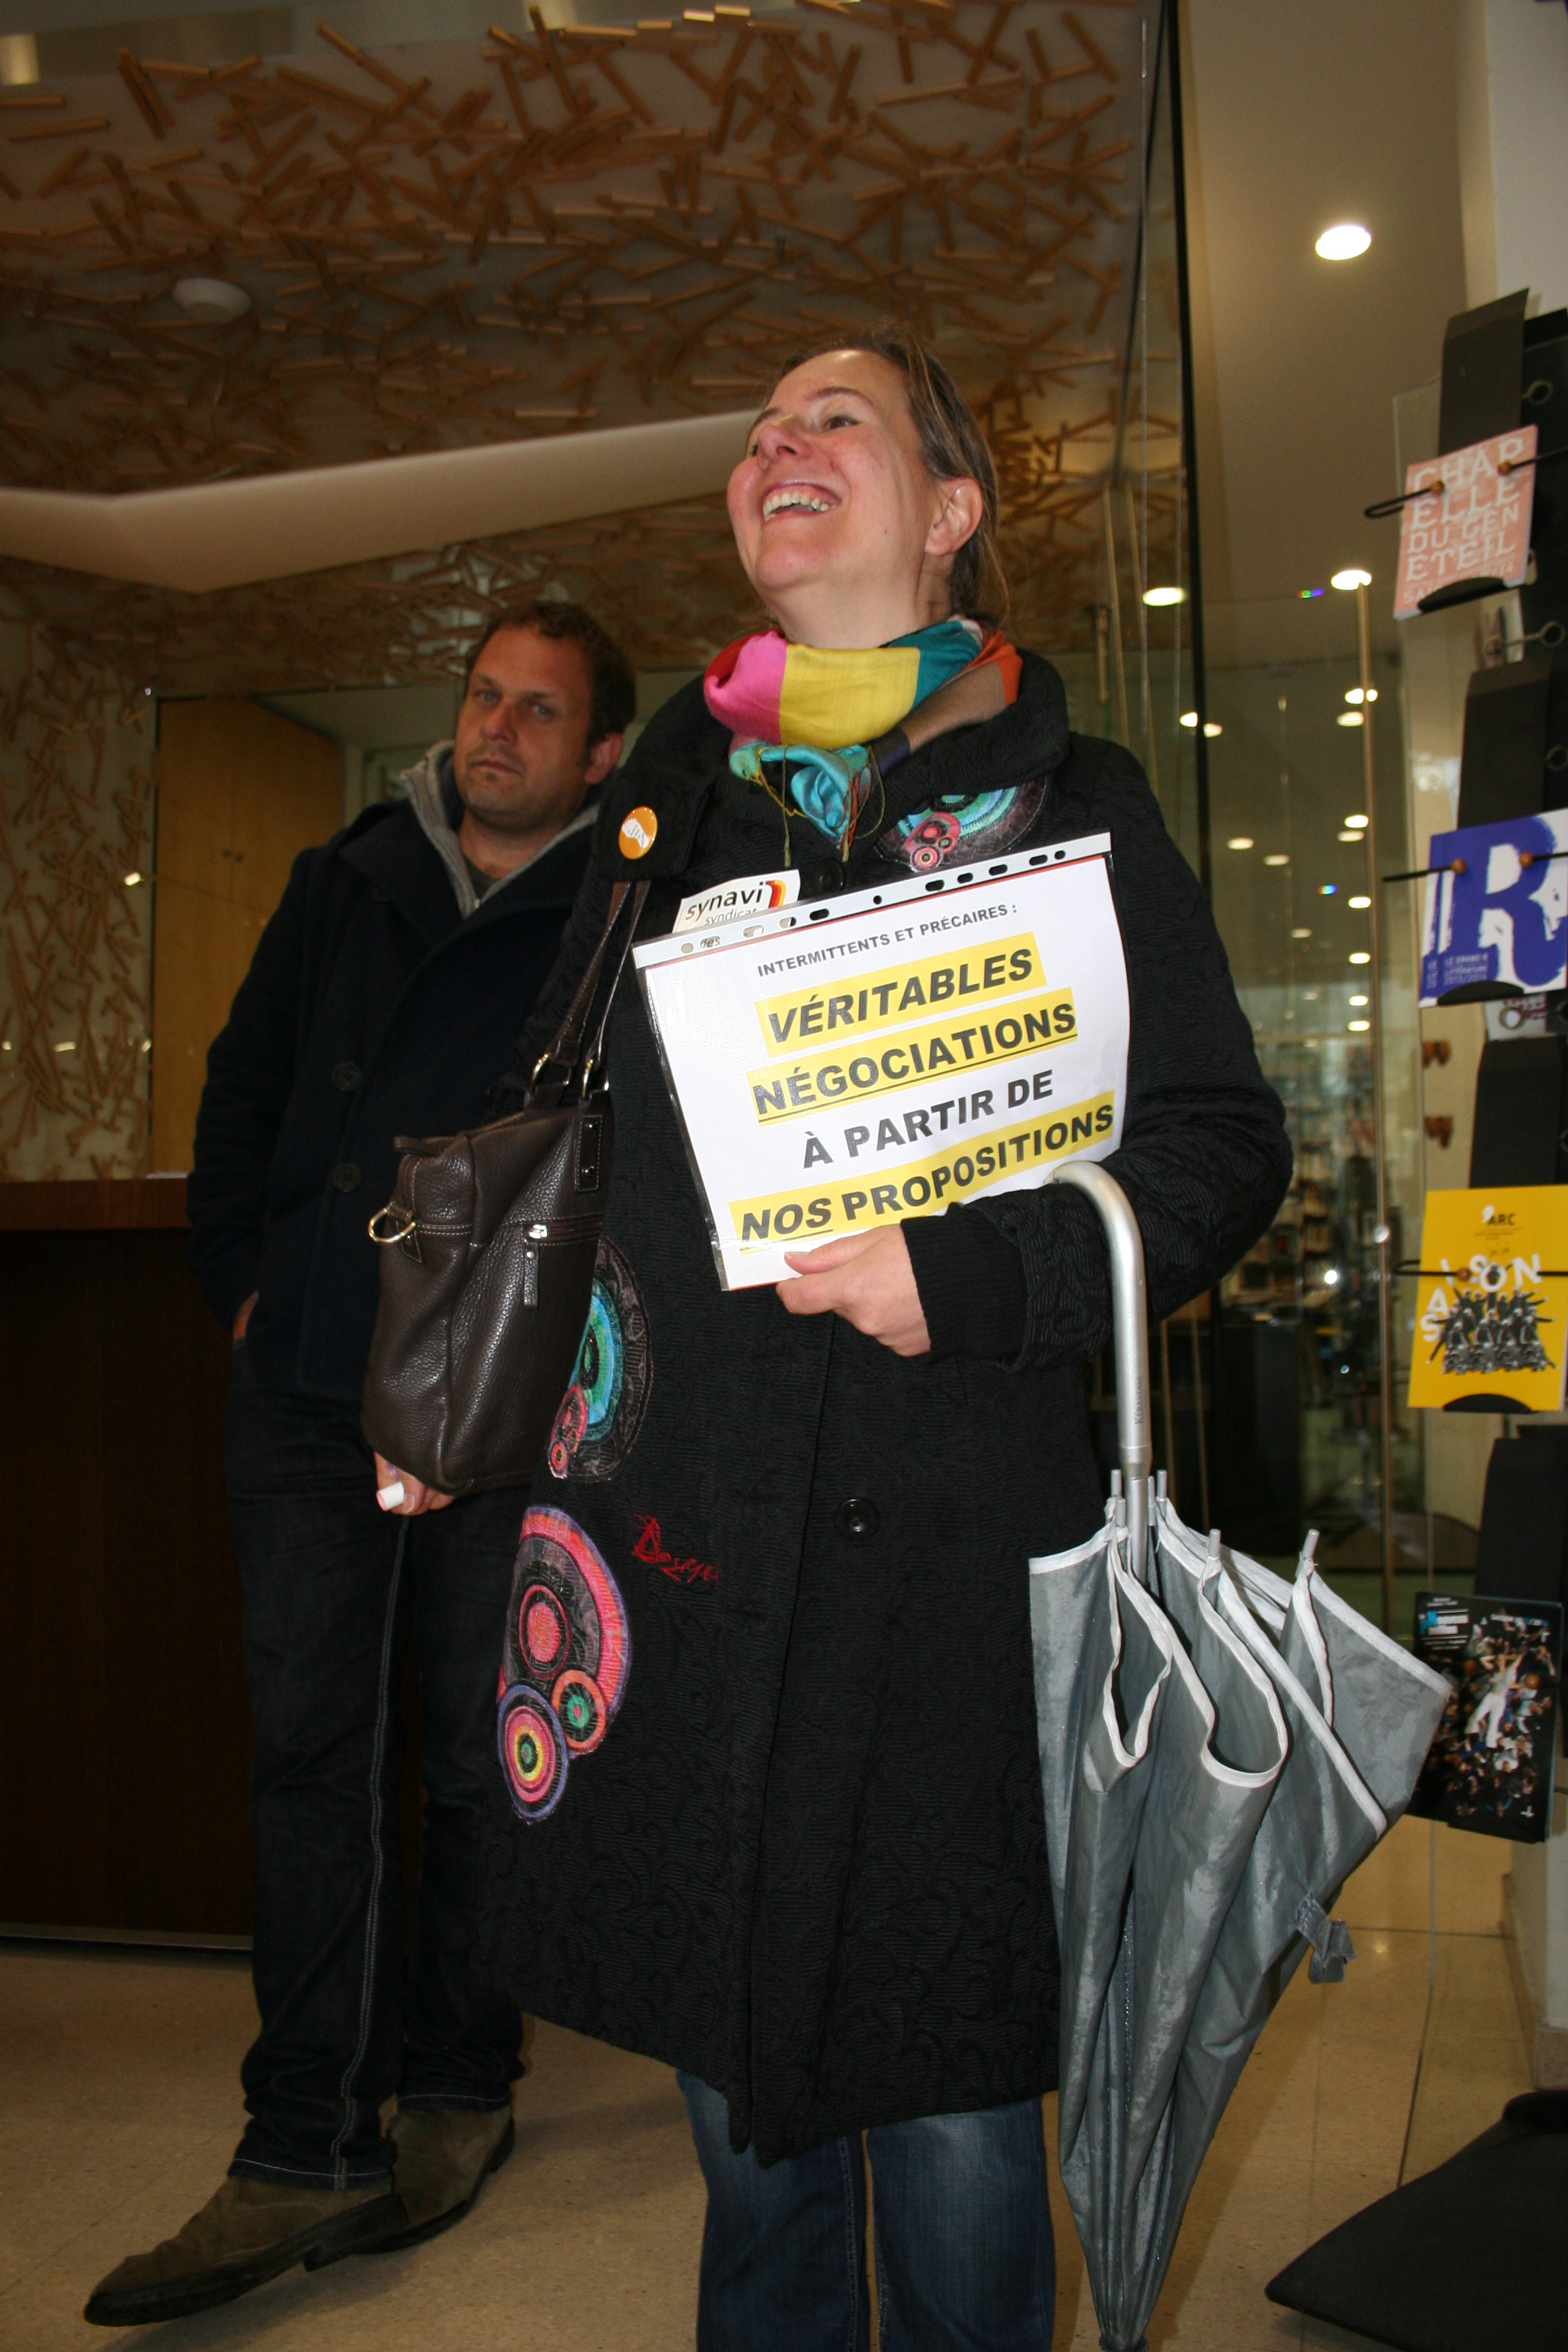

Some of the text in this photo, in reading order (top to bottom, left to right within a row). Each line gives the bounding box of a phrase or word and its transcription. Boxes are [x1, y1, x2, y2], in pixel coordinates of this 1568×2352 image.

[1413, 438, 1524, 492] CHAP
[1406, 504, 1520, 555] DU GEN
[1410, 472, 1521, 531] ELLE
[1405, 531, 1516, 582] ETEIL
[685, 881, 764, 923] synavi
[757, 933, 891, 978] INTERMITTENTS
[894, 927, 915, 943] ET
[919, 904, 1009, 936] PRÉCAIRES
[768, 948, 1033, 1044] VÉRITABLES
[753, 1002, 1076, 1116] NÉGOCIATIONS
[802, 1069, 1054, 1169] À PARTIR DE
[741, 1104, 1114, 1242] NOS PROPOSITIONS
